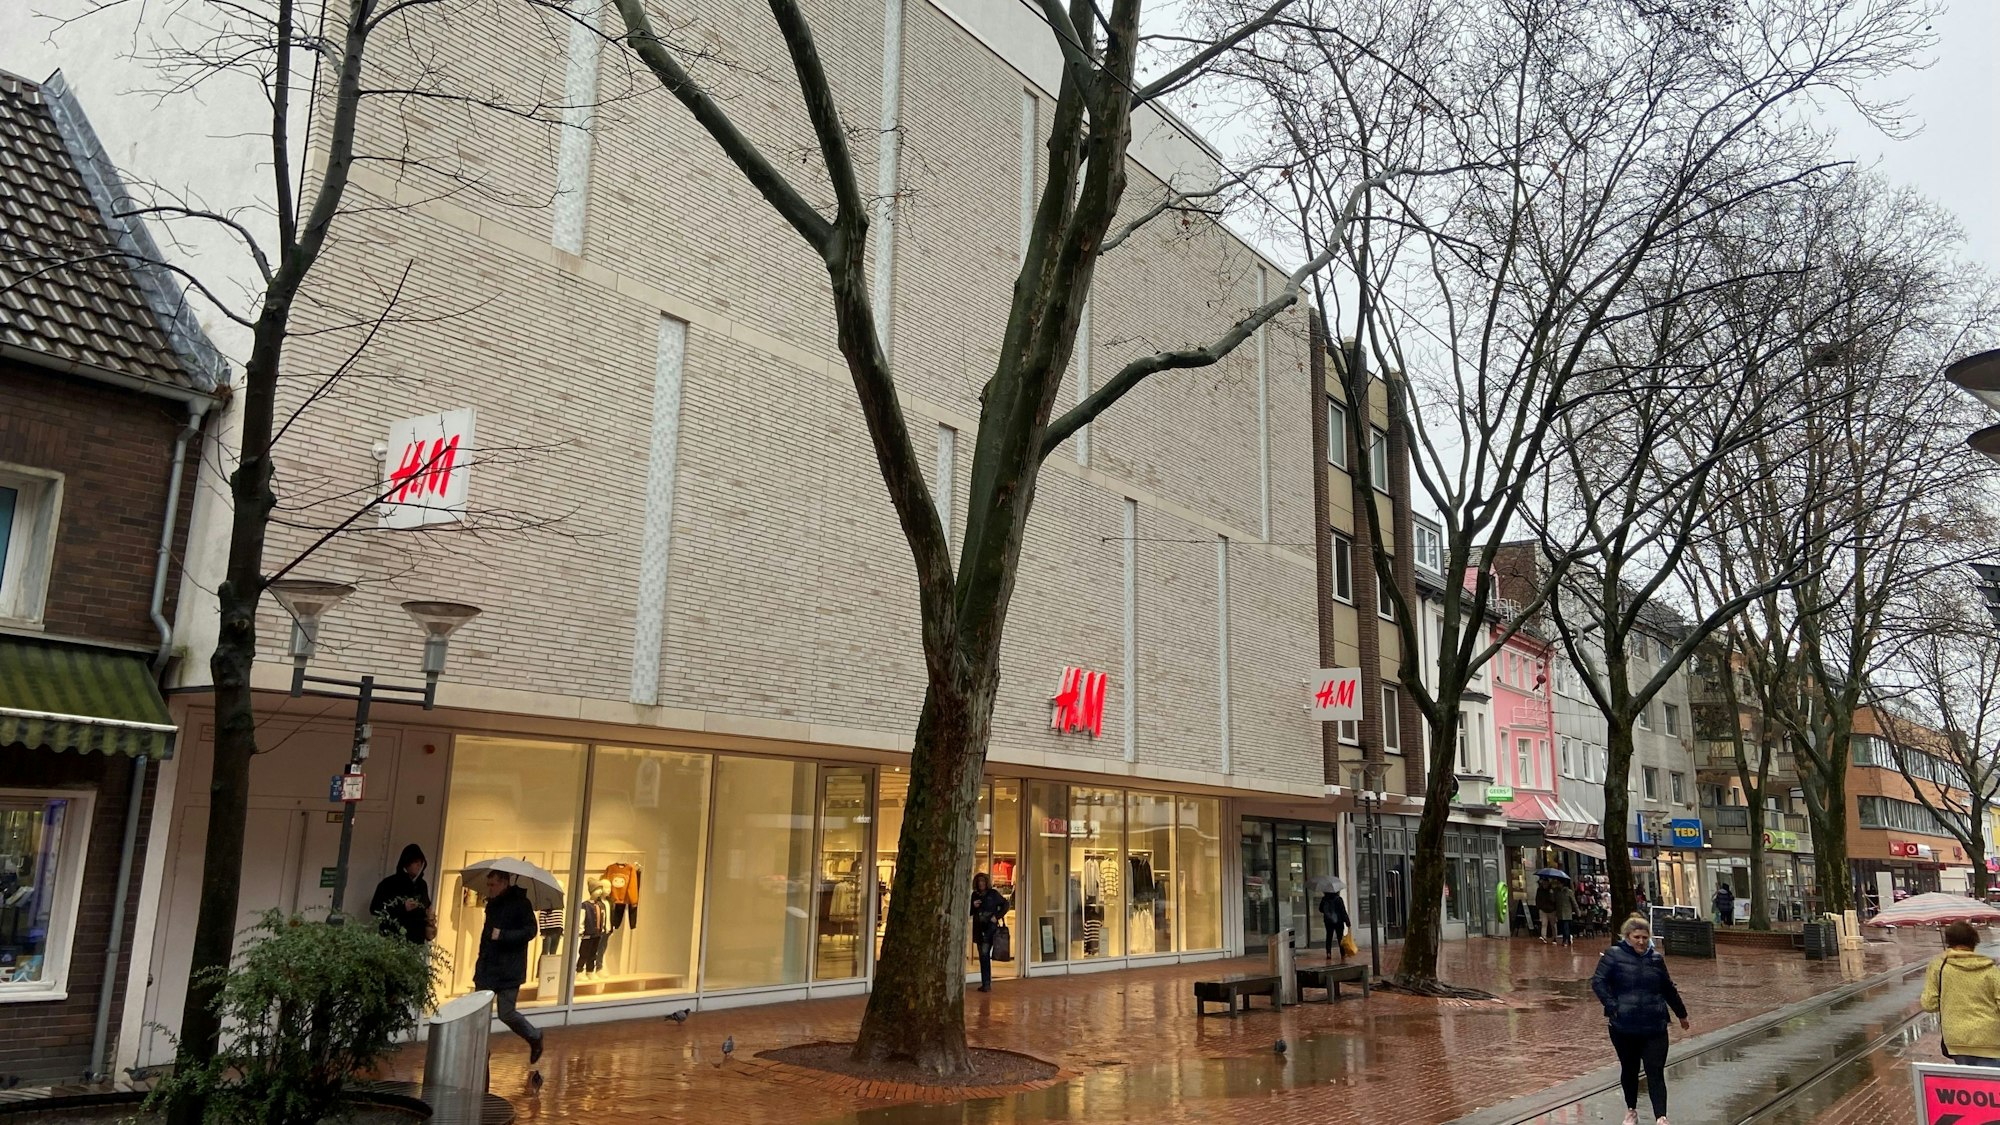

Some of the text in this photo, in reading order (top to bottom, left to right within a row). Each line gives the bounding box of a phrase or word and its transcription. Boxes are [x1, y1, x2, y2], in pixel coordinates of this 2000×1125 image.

[389, 434, 460, 504] H&M
[1052, 665, 1107, 738] H&M
[1315, 679, 1356, 709] H&M
[1674, 827, 1699, 837] TEDi
[1935, 1087, 2000, 1109] WOOL
